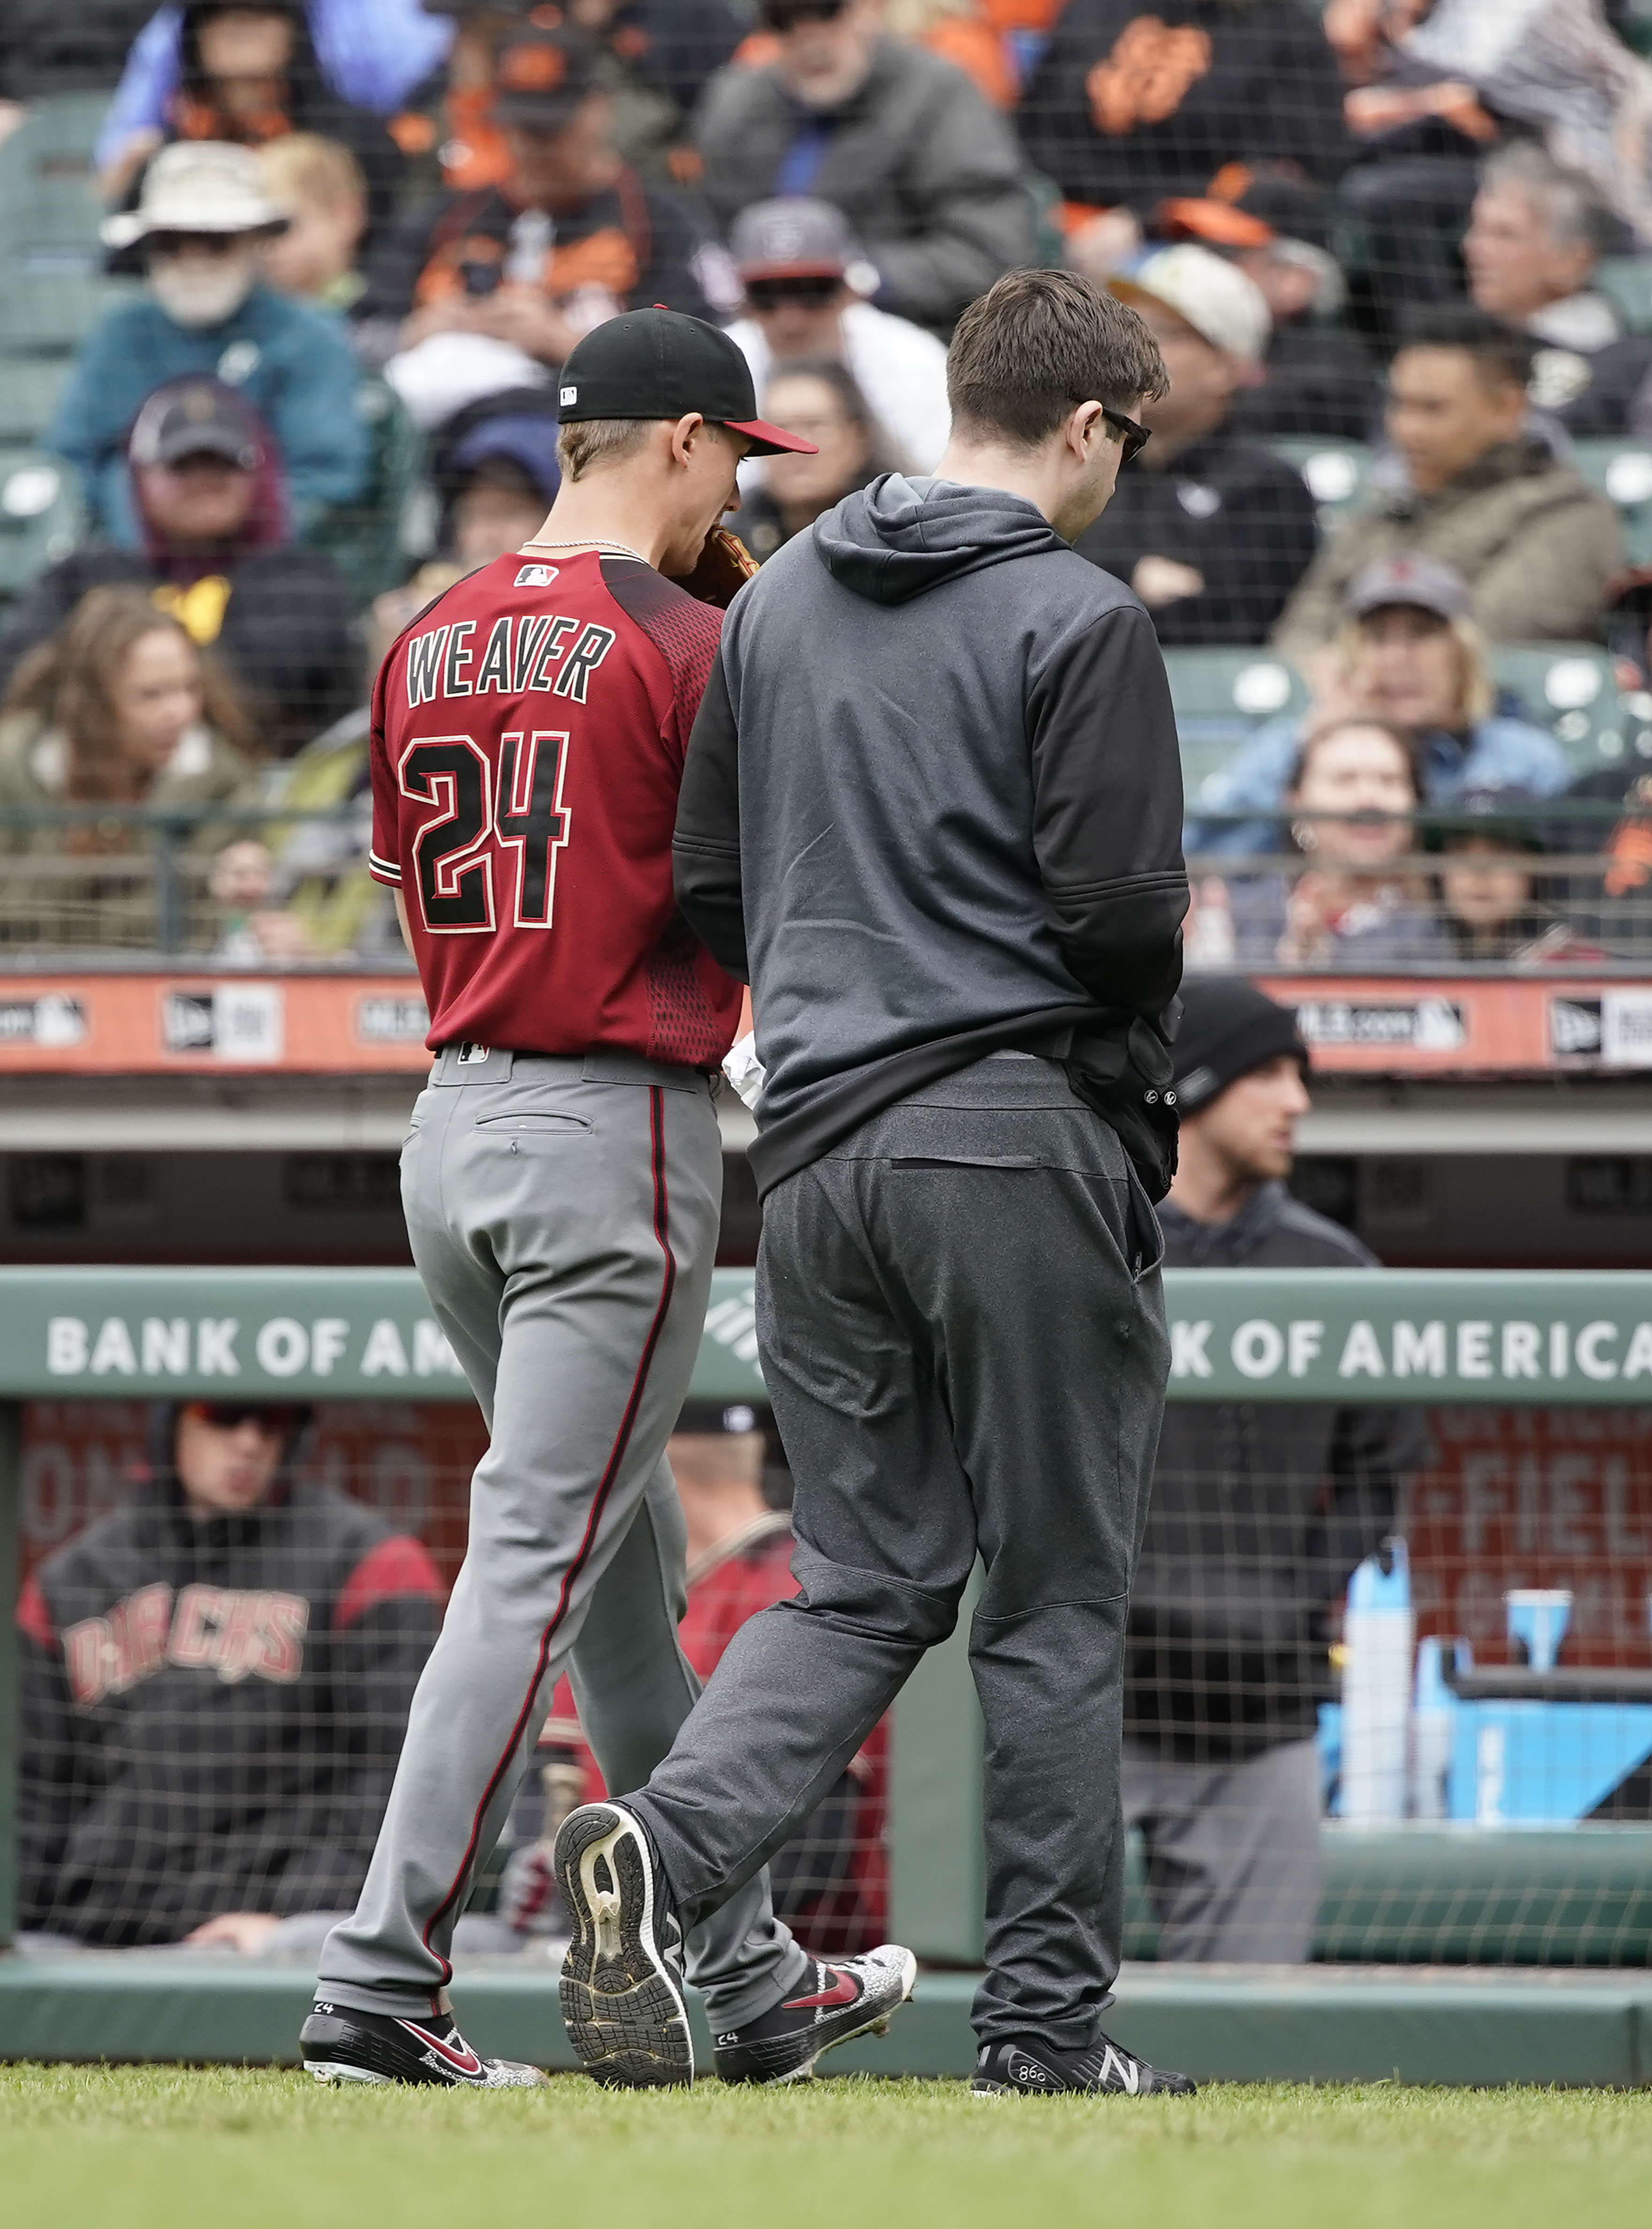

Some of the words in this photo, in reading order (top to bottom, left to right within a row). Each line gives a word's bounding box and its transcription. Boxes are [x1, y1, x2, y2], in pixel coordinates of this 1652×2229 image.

[407, 615, 616, 709] WEAVER
[398, 730, 572, 934] 24
[48, 1316, 241, 1377] BANK
[256, 1316, 350, 1377] OF
[1229, 1319, 1326, 1379] OF
[1337, 1319, 1652, 1380] AMERICA
[1019, 2064, 1046, 2082] 860
